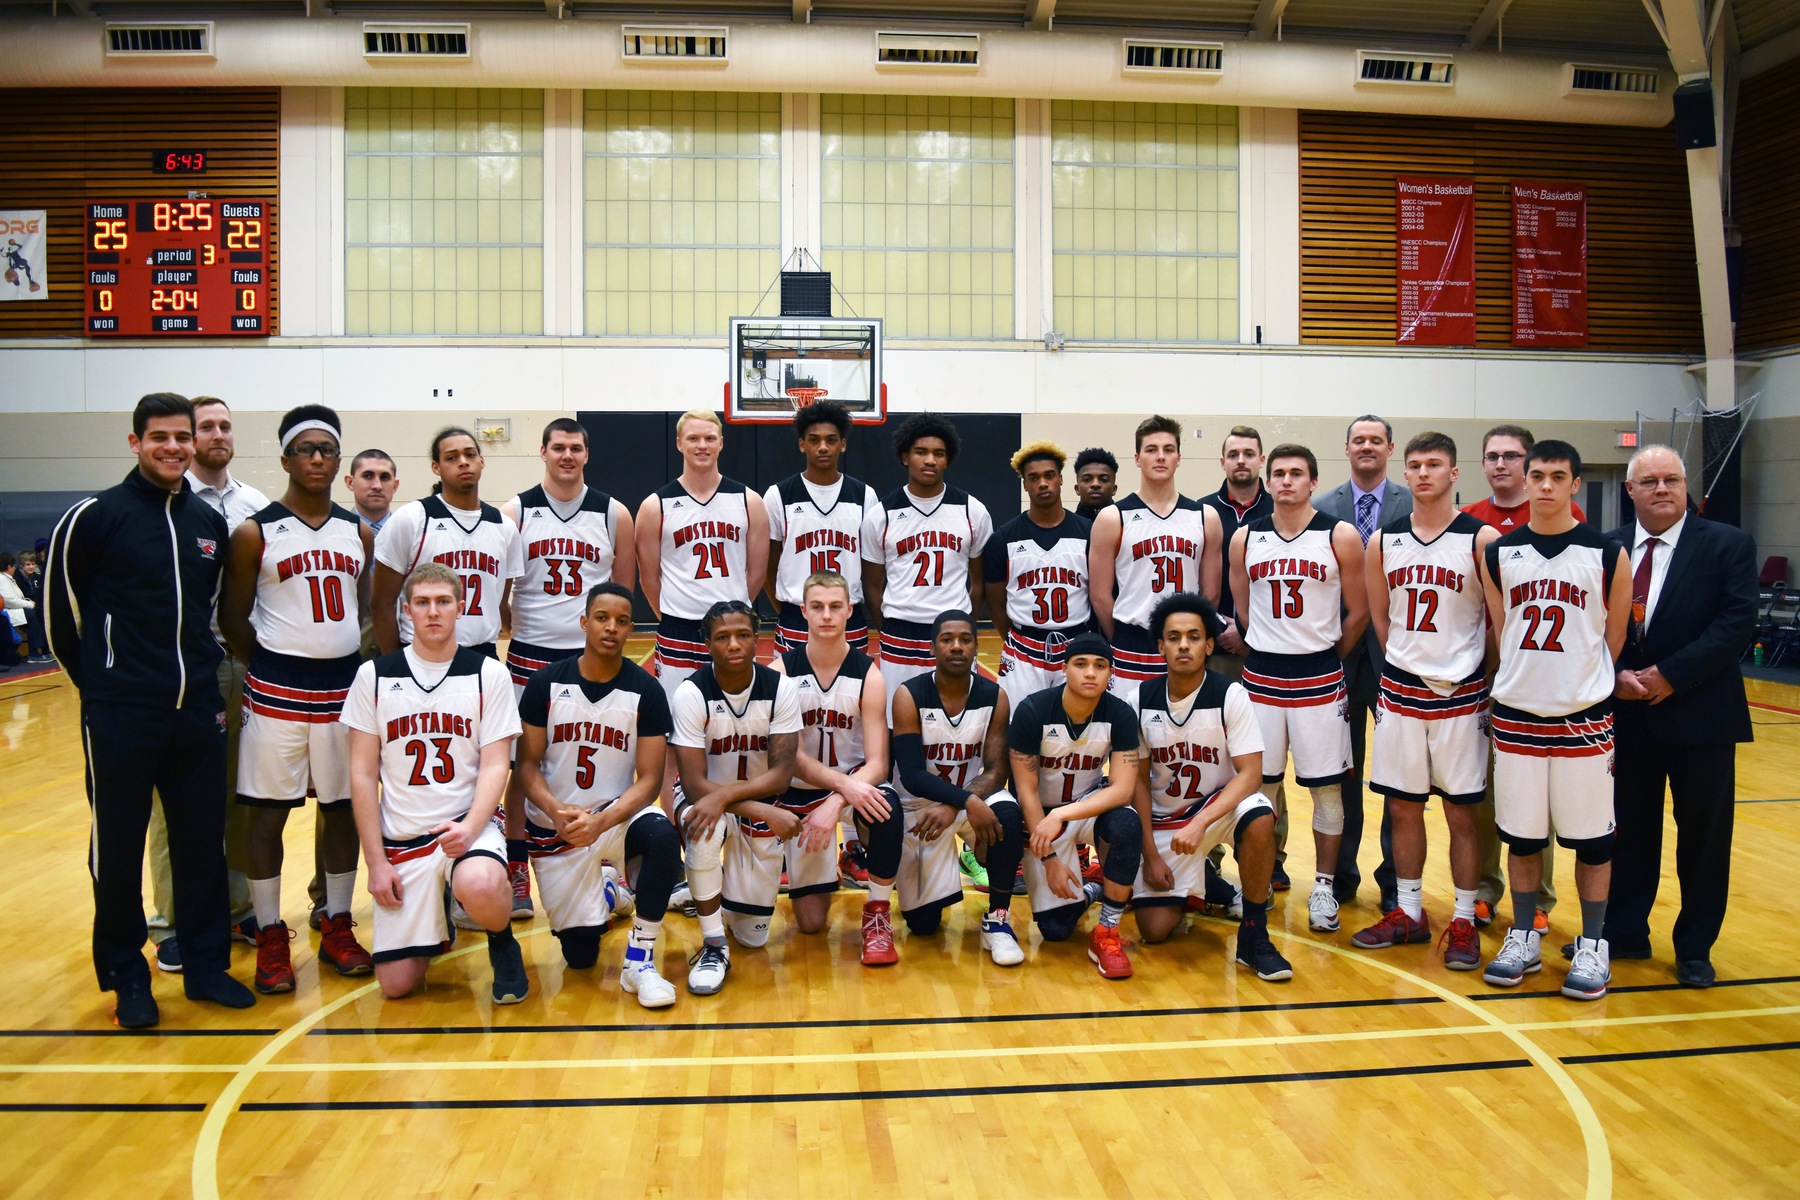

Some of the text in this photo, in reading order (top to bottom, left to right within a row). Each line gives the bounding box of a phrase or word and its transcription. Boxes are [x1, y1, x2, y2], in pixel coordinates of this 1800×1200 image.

[165, 153, 204, 170] 6:43
[1399, 182, 1473, 195] Women's Basketball
[1514, 187, 1583, 200] Men's Basketball
[93, 205, 123, 218] Home
[153, 203, 213, 231] 8:25
[222, 204, 261, 217] Guests
[93, 221, 128, 250] 25
[227, 220, 261, 249] 22
[157, 250, 192, 264] period
[203, 244, 215, 266] 3
[91, 271, 116, 284] fouls
[157, 270, 192, 284] player
[234, 270, 259, 283] fouls
[100, 289, 113, 312] 0
[151, 290, 198, 311] 2-04
[242, 289, 256, 311] 0
[93, 319, 114, 329] won
[162, 318, 189, 331] game
[236, 318, 257, 328] won
[673, 521, 741, 549] MUSTANGS
[795, 528, 857, 555] MUSTANGS
[896, 530, 963, 558] MUSTANGS
[1132, 534, 1198, 562] MUSTANGS
[528, 537, 601, 565] MUSTANGS
[692, 542, 729, 580] 24
[276, 549, 360, 583] MUSTANGS
[543, 558, 583, 596] 33
[912, 550, 944, 587] 21
[1017, 566, 1082, 592] MUSTANGS
[1150, 556, 1184, 593] 34
[1249, 558, 1328, 583] MUSTANGS
[1388, 564, 1465, 594] MUSTANGS
[304, 575, 345, 623] 10
[1031, 587, 1069, 624] 30
[1267, 579, 1305, 619] 13
[1510, 578, 1589, 611] MUSTANGS
[1405, 588, 1439, 633] 12
[1519, 604, 1565, 653] 22
[386, 711, 473, 744] MUSTANGS
[552, 721, 631, 753] MUSTANGS
[405, 738, 455, 786] 23
[575, 745, 599, 790] 5
